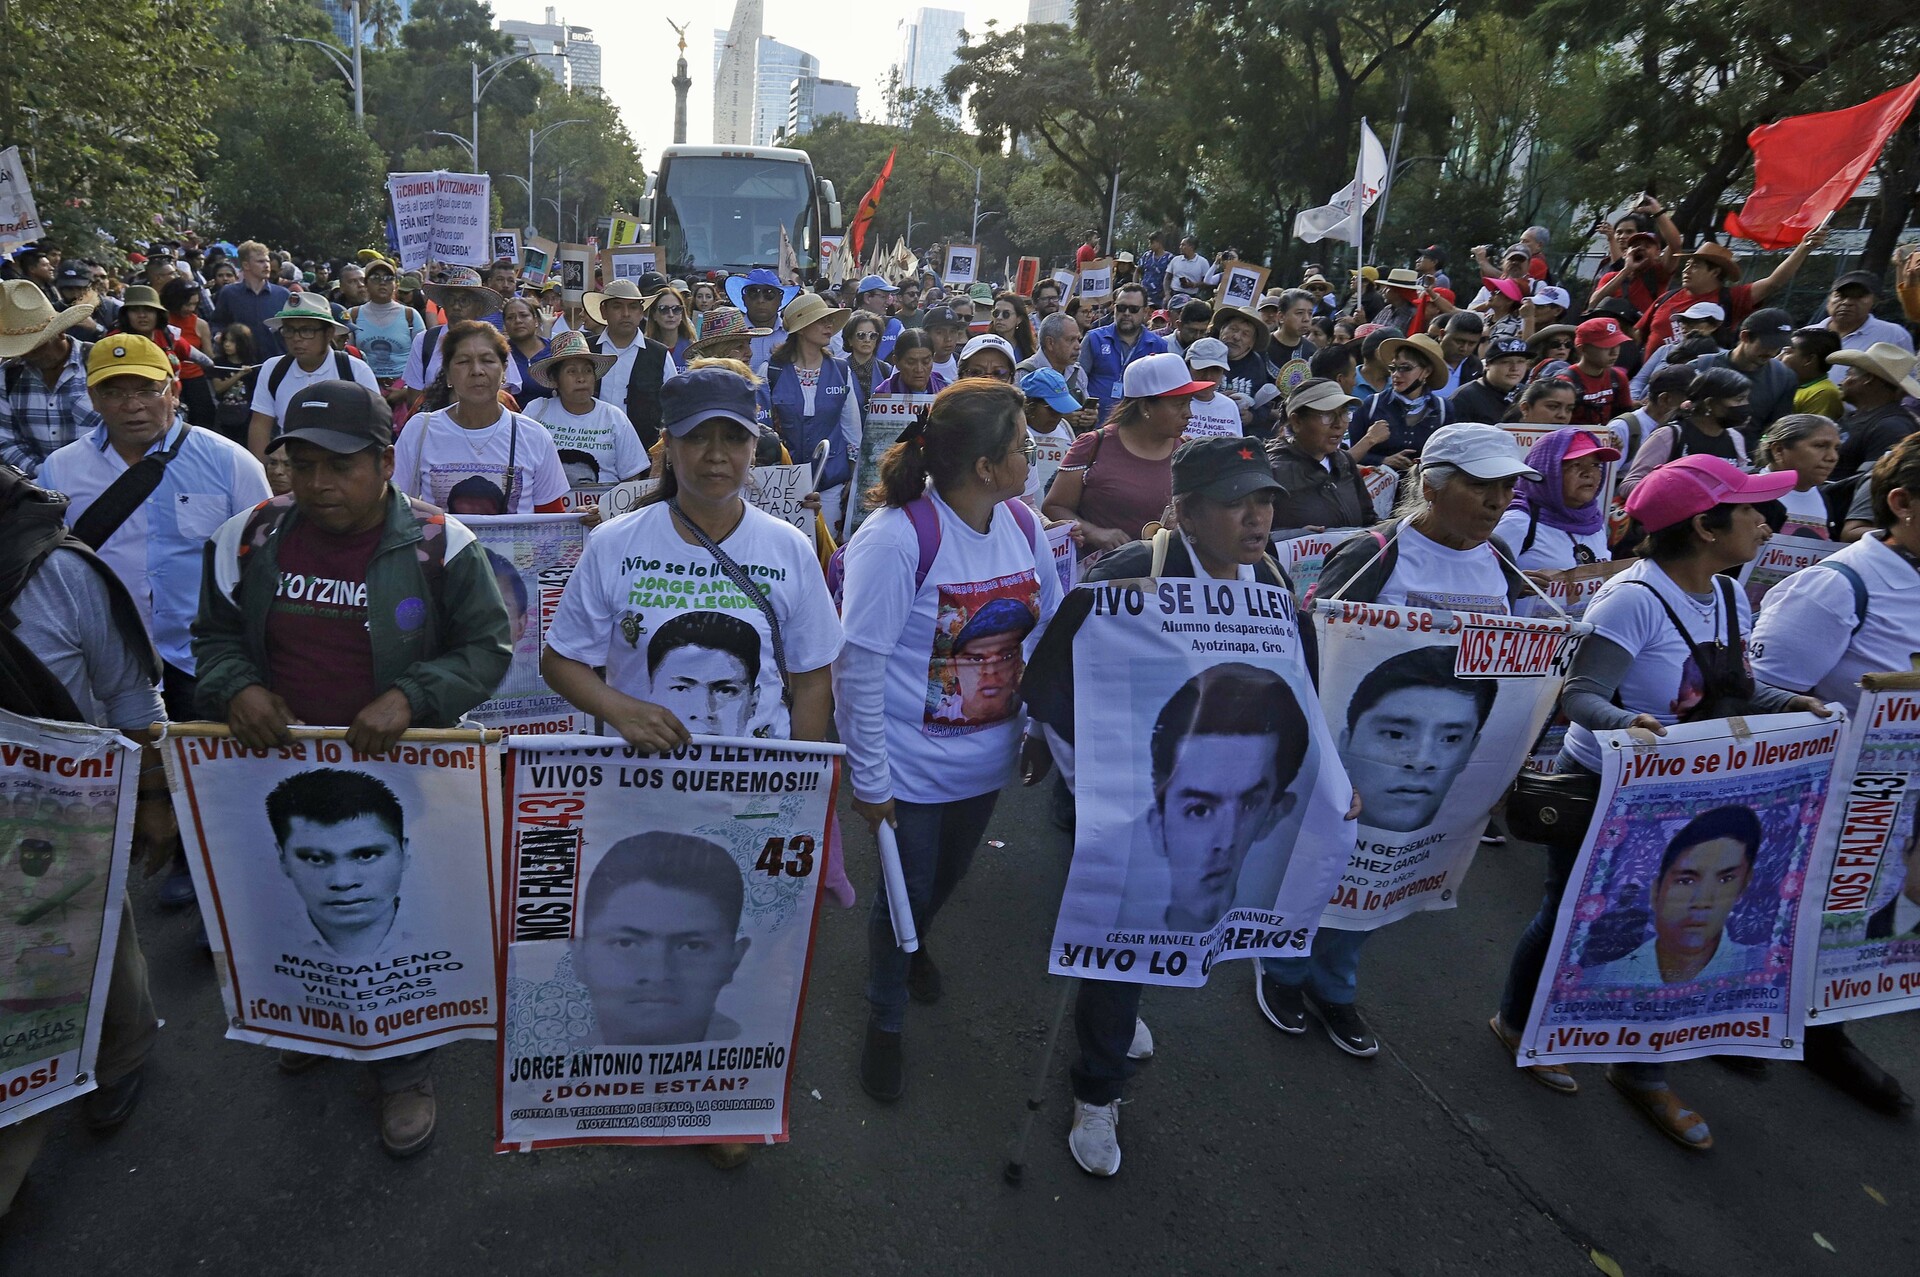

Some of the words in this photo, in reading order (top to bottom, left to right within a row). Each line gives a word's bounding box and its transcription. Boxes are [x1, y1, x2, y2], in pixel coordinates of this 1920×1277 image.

[396, 181, 435, 199] ¡¡CRIMEN
[413, 201, 419, 212] al
[451, 201, 461, 211] que
[462, 200, 472, 210] con
[400, 215, 416, 231] PEÑA
[470, 216, 478, 226] de
[436, 229, 452, 239] ahora
[453, 231, 464, 241] con
[825, 386, 847, 395] CIDH
[869, 402, 888, 415] ivo
[891, 404, 904, 415] se
[553, 433, 596, 442] BENJAMÍN
[1048, 450, 1061, 461] se
[1293, 539, 1332, 562] ¡Vivo
[1761, 549, 1793, 567] ¡Vivo
[1795, 556, 1808, 568] se
[621, 556, 661, 576] ¡Vivo
[665, 563, 686, 576] se
[689, 561, 707, 577] lo
[709, 563, 786, 581] llearon!
[634, 577, 695, 595] JORGE
[698, 580, 771, 597] ANTO
[628, 590, 689, 610] TIZAPA
[1092, 583, 1144, 617] IVO
[1158, 583, 1194, 615] SE
[1204, 585, 1235, 616] LO
[1161, 620, 1210, 634] Alumno
[1214, 621, 1285, 637] desaparecido
[1407, 611, 1432, 632] se
[1191, 638, 1259, 655] Ayotzinapa,
[1262, 641, 1286, 654] Gro.
[1457, 629, 1497, 673] NOS
[1494, 632, 1561, 673] FALTAN
[1551, 634, 1585, 677] 43
[1750, 642, 1765, 659] 43
[0, 744, 115, 778] varon!
[315, 739, 342, 764] lo
[1622, 752, 1685, 787] ¡Vivo
[1692, 754, 1720, 774] se
[1725, 744, 1748, 771] lo
[1752, 728, 1839, 768] llevaron!
[531, 765, 603, 788] VIVOS
[619, 767, 664, 789] LOS
[671, 770, 820, 793] QUEREMOS!!!
[1849, 770, 1909, 800] 43!
[518, 790, 586, 829] 43!
[1371, 832, 1447, 858] GETSEMANY
[1836, 800, 1896, 867] FALTAN
[518, 829, 581, 899] FALTAN
[754, 834, 817, 879] 43
[1393, 849, 1430, 871] GARCÍA
[1362, 890, 1382, 911] lo
[1382, 870, 1448, 911] queremos!
[1373, 880, 1389, 888] 20
[1391, 869, 1417, 885] AÑOS
[1827, 872, 1873, 911] NOS
[516, 902, 574, 942] NOS
[1106, 929, 1146, 945] CÉSAR
[1148, 934, 1196, 947] MANUEL
[281, 950, 452, 975] MAGDALENO
[1060, 942, 1137, 973] VIVO
[1149, 950, 1188, 977] LO
[273, 963, 358, 988] RUBÉN
[367, 961, 464, 986] LAURO
[301, 976, 433, 1001] VILLEGAS
[305, 994, 350, 1011] EDAD
[357, 1001, 379, 1012] 19
[384, 987, 438, 1007] AÑOS
[1713, 987, 1780, 1004] GUERRERO
[1824, 978, 1873, 1008] ¡Vivo
[1877, 972, 1894, 994] lo
[250, 997, 292, 1022] ¡Con
[297, 1005, 346, 1034] VIDA
[350, 1013, 369, 1038] lo
[375, 995, 489, 1038] queremos!
[1547, 1028, 1609, 1052] ¡Vivo
[1617, 1026, 1641, 1046] lo
[1650, 1016, 1770, 1051] queremos!
[510, 1055, 564, 1083] JORGE
[569, 1052, 643, 1079] ANTONIO
[648, 1049, 702, 1076] TIZAPA
[706, 1041, 786, 1072] LEGIDEÑO
[541, 1081, 645, 1103] ¿DÓNDE
[655, 1075, 751, 1096] ESTÁN?
[510, 1108, 553, 1121] CONTRA
[555, 1107, 569, 1118] EL
[570, 1103, 636, 1118] TERRORISMO
[637, 1103, 652, 1115] DE
[653, 1099, 695, 1114] ESTADO,
[696, 1099, 710, 1112] LA
[711, 1098, 775, 1111] SOLIDARIDAD
[575, 1116, 639, 1130] AYOTZINAPA
[640, 1114, 676, 1129] SOMOS
[677, 1114, 712, 1128] TODOS
